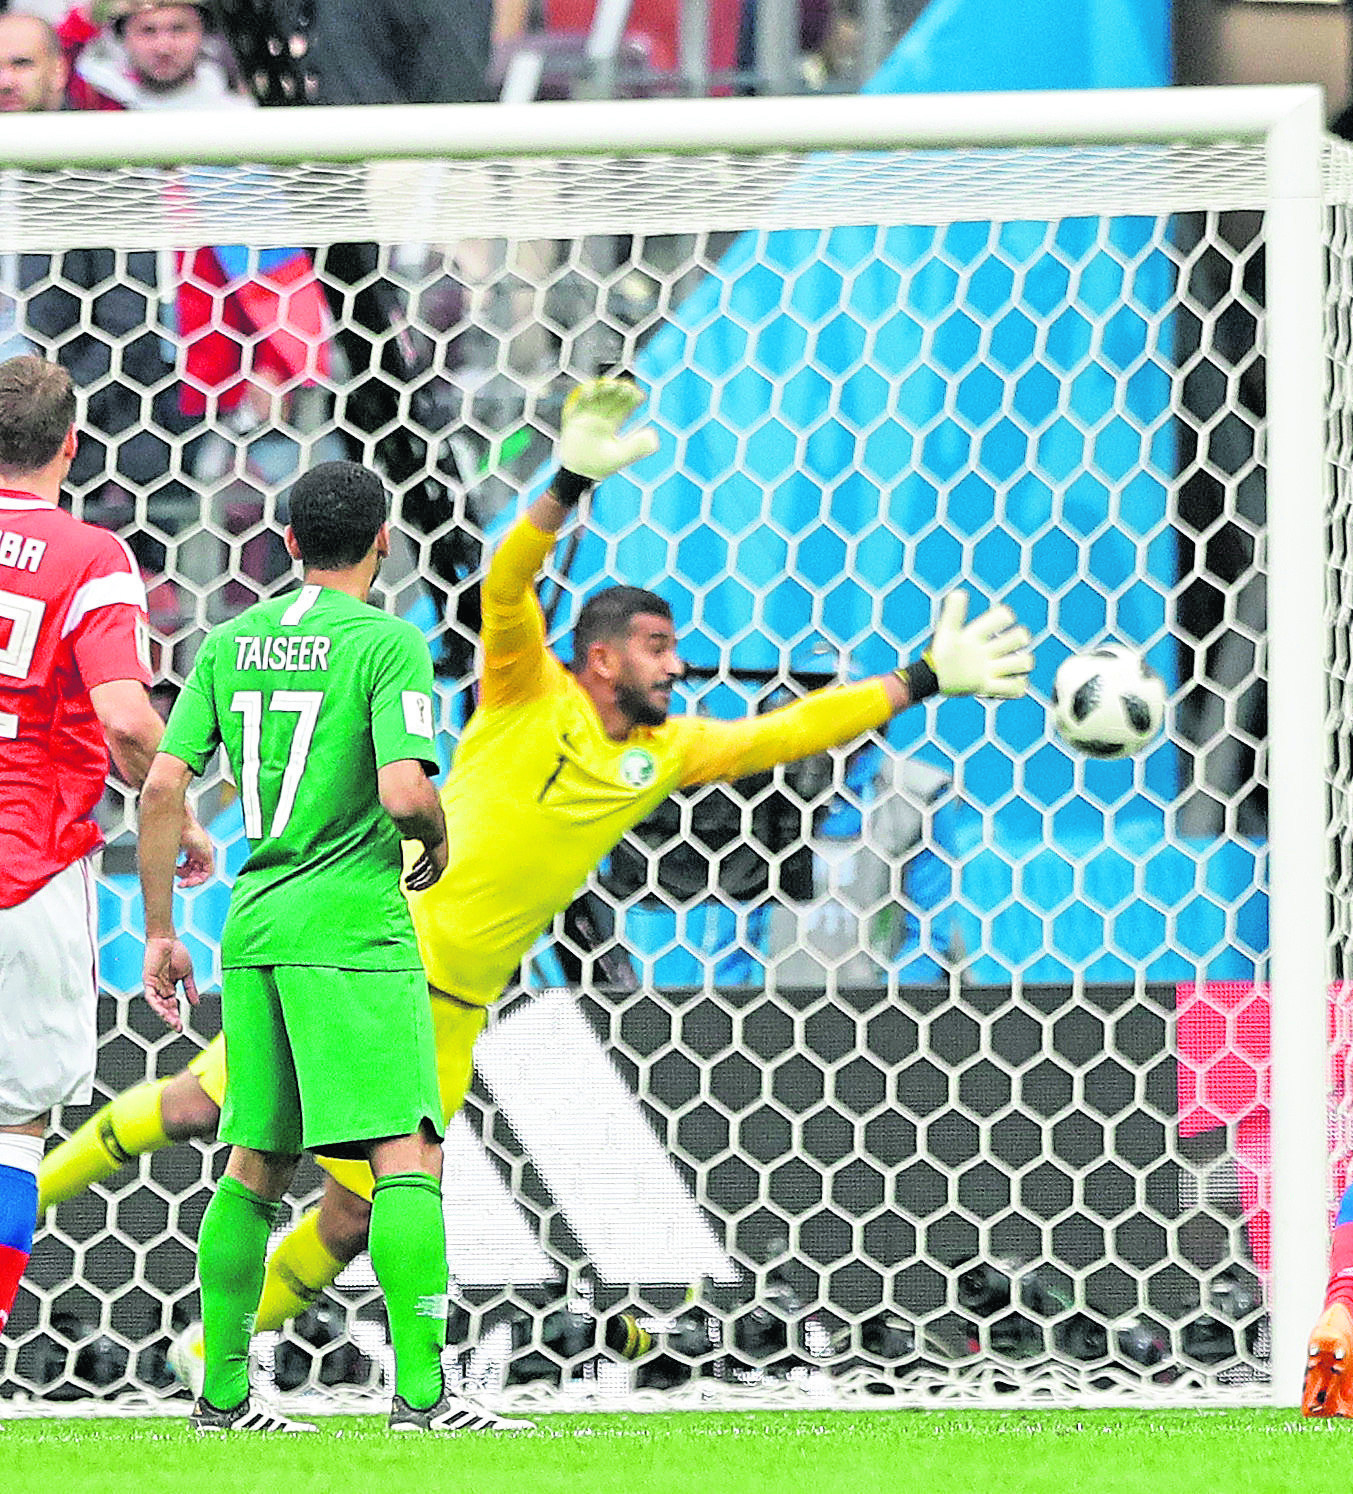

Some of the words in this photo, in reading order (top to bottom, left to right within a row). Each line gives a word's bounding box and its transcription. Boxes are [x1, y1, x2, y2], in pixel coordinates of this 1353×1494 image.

[0, 529, 48, 573] BA
[234, 635, 331, 671] TAISEER
[229, 690, 324, 839] 17
